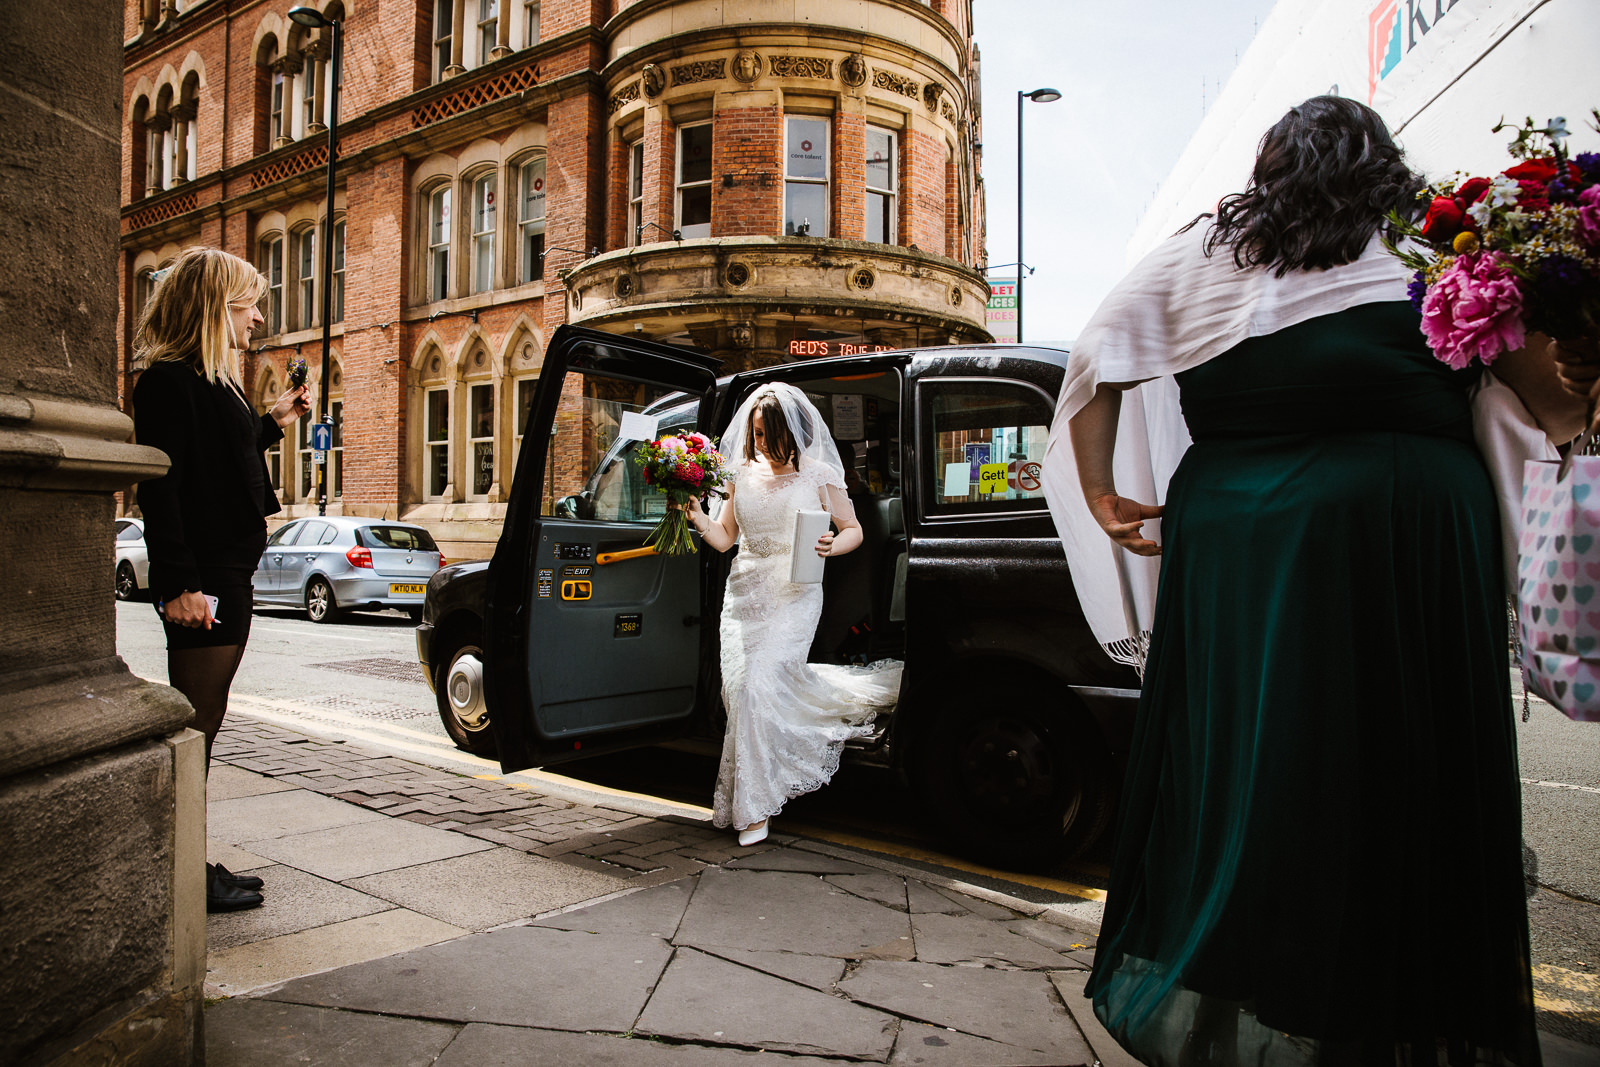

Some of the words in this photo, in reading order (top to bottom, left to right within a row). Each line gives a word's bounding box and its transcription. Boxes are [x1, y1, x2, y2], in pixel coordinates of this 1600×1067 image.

[992, 286, 1014, 295] LET
[987, 297, 1015, 308] ICES
[790, 340, 829, 356] RED'S
[966, 447, 990, 467] silks
[982, 469, 1005, 481] Gett
[411, 585, 424, 593] NLN
[621, 622, 637, 632] 1368
